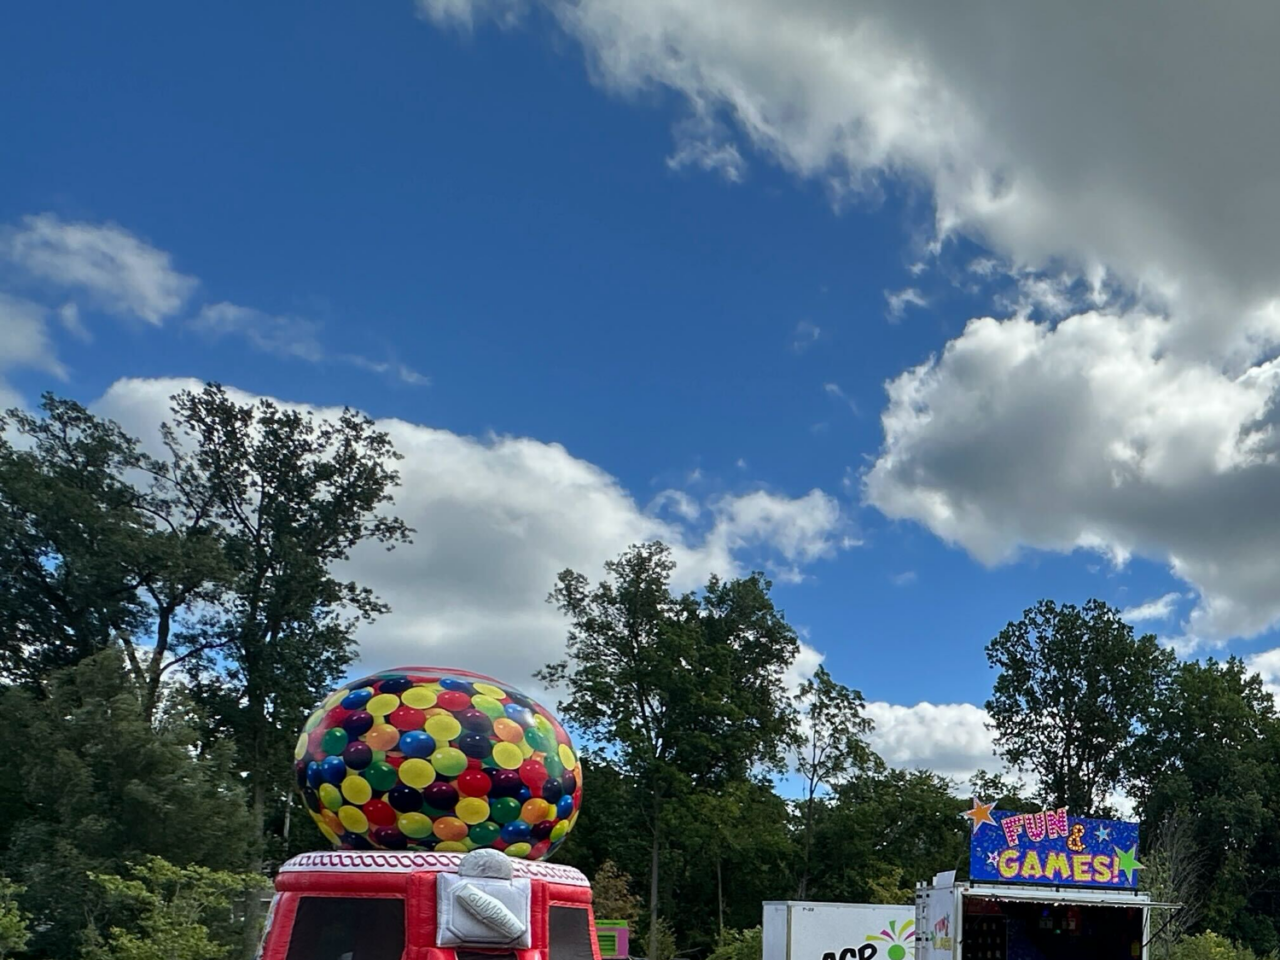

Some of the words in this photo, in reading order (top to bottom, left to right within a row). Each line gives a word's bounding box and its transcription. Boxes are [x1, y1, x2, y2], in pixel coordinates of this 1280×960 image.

[1001, 808, 1068, 847] FUN
[1066, 823, 1086, 852] &
[998, 848, 1120, 884] GAMES!
